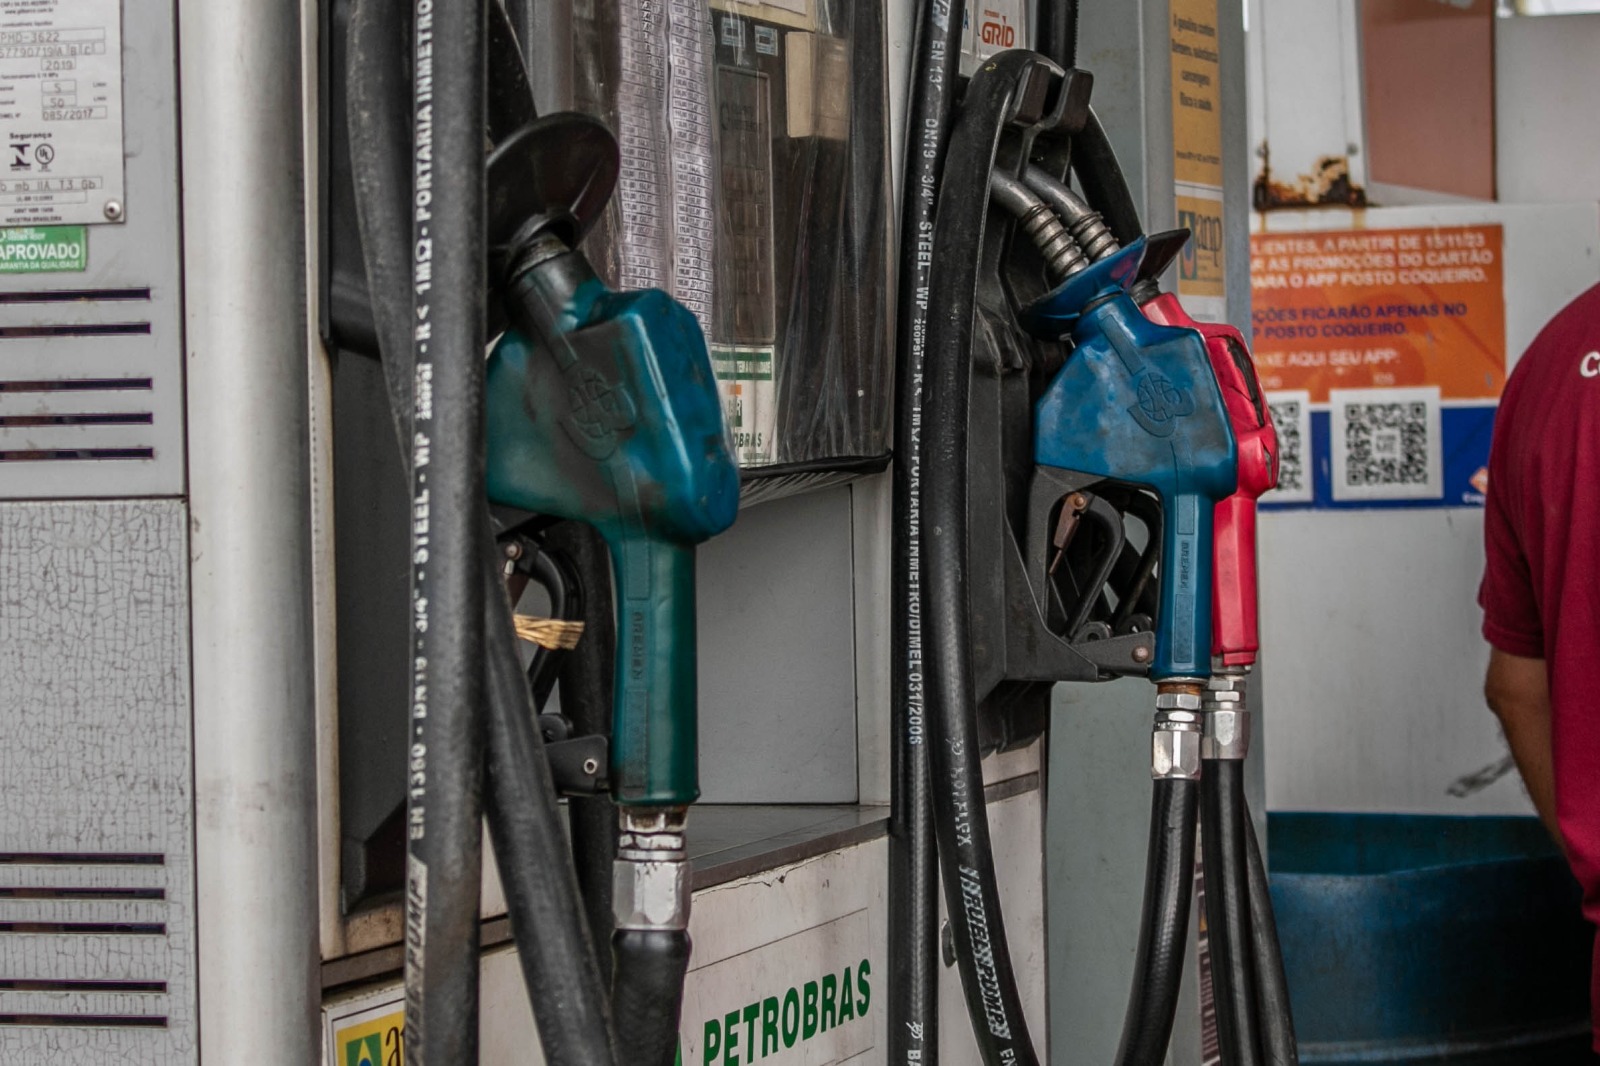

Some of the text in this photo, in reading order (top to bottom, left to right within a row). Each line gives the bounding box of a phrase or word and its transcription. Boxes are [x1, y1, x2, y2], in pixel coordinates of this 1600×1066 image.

[982, 15, 1015, 48] GRID
[931, 40, 946, 61] EN
[45, 60, 74, 72] 2019
[42, 108, 94, 121] 085/2017
[50, 97, 66, 109] 50
[9, 132, 53, 141] Segurança
[923, 118, 939, 159] DN19
[416, 104, 432, 222] PORTARIA
[81, 178, 96, 191] Gb
[917, 221, 933, 270] STEEL
[1398, 234, 1421, 249] DE
[1426, 246, 1494, 266] CARTÃO
[1289, 273, 1303, 288] O
[1340, 269, 1396, 287] POSTO
[915, 287, 929, 310] WP
[1301, 303, 1372, 321] FICARÃO
[1375, 303, 1440, 318] APENAS
[1443, 302, 1468, 316] NO
[912, 318, 922, 356] 260PSI
[1265, 324, 1318, 339] POSTO
[1580, 351, 1600, 377] C
[414, 432, 431, 468] WP
[414, 488, 430, 564] STEEL
[908, 673, 924, 746] 031/2006
[410, 807, 426, 840] EN
[407, 879, 430, 971] PUMP
[963, 891, 990, 950] FUEL
[977, 957, 1005, 1028] PUMP
[703, 958, 871, 1066] PETROBRAS
